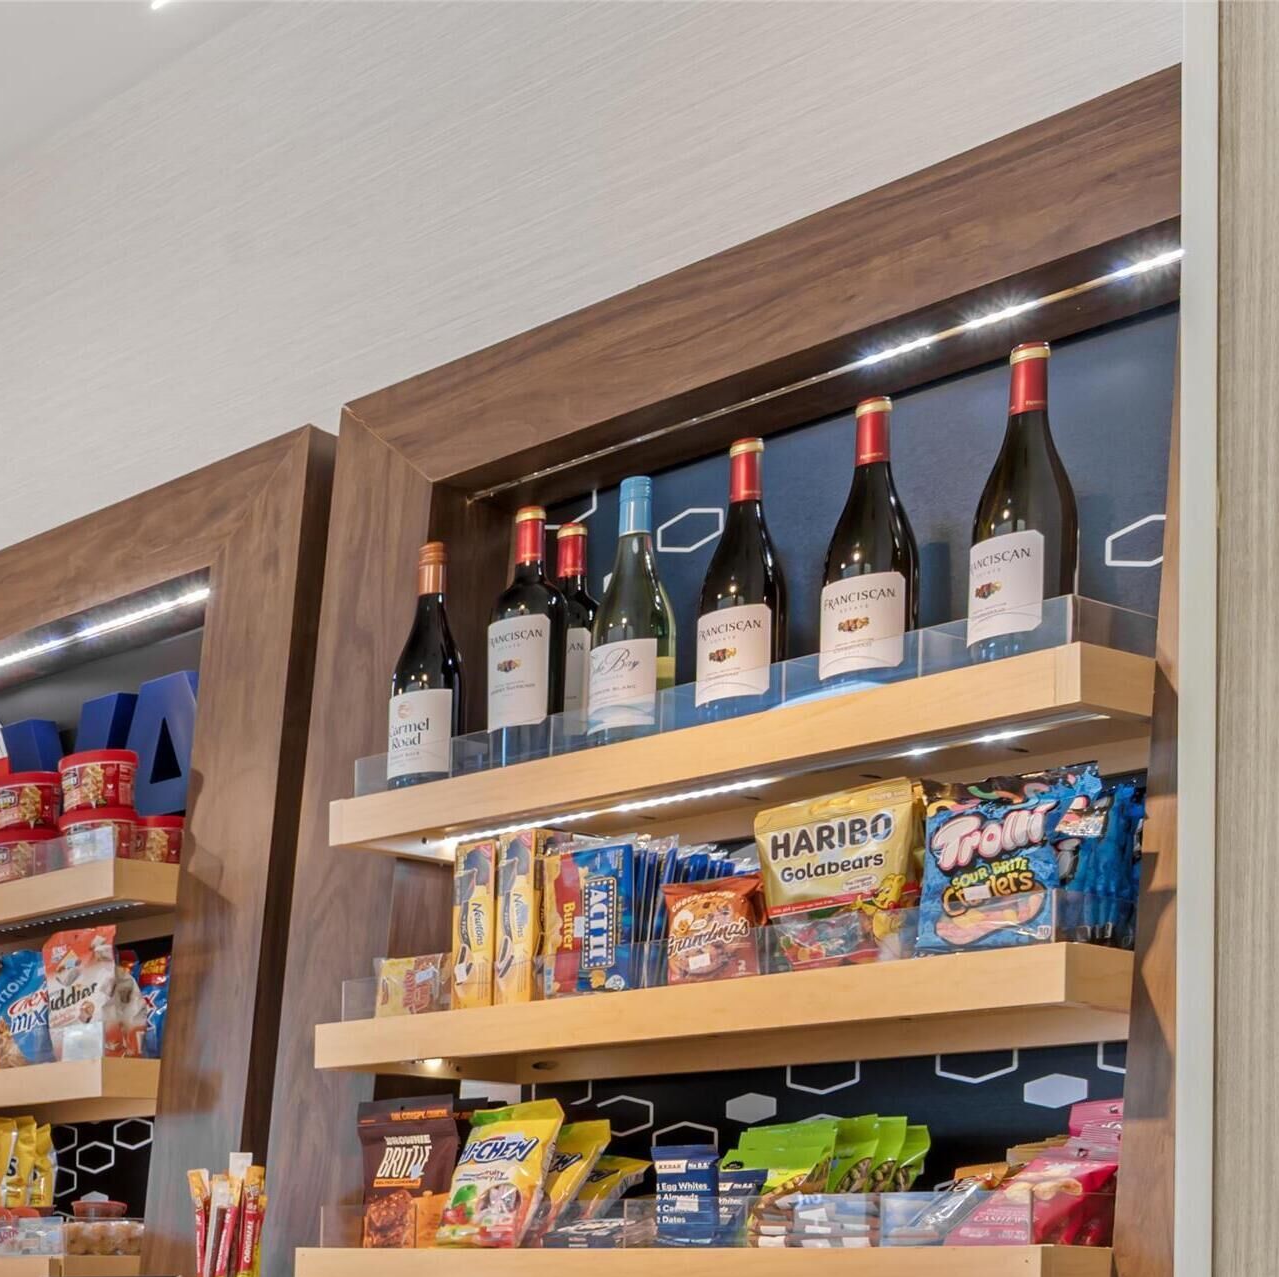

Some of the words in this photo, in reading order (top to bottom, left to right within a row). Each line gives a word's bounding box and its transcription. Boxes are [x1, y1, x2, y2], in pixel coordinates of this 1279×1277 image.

[771, 812, 893, 861] HARIBO
[952, 868, 989, 888] SOUR
[993, 857, 1029, 876] BRITE
[471, 902, 485, 946] Newtons
[562, 901, 575, 950] Butter
[668, 919, 749, 957] Grandma's
[662, 1183, 677, 1192] Egg
[679, 1182, 708, 1190] Whites
[662, 1216, 686, 1224] Dates
